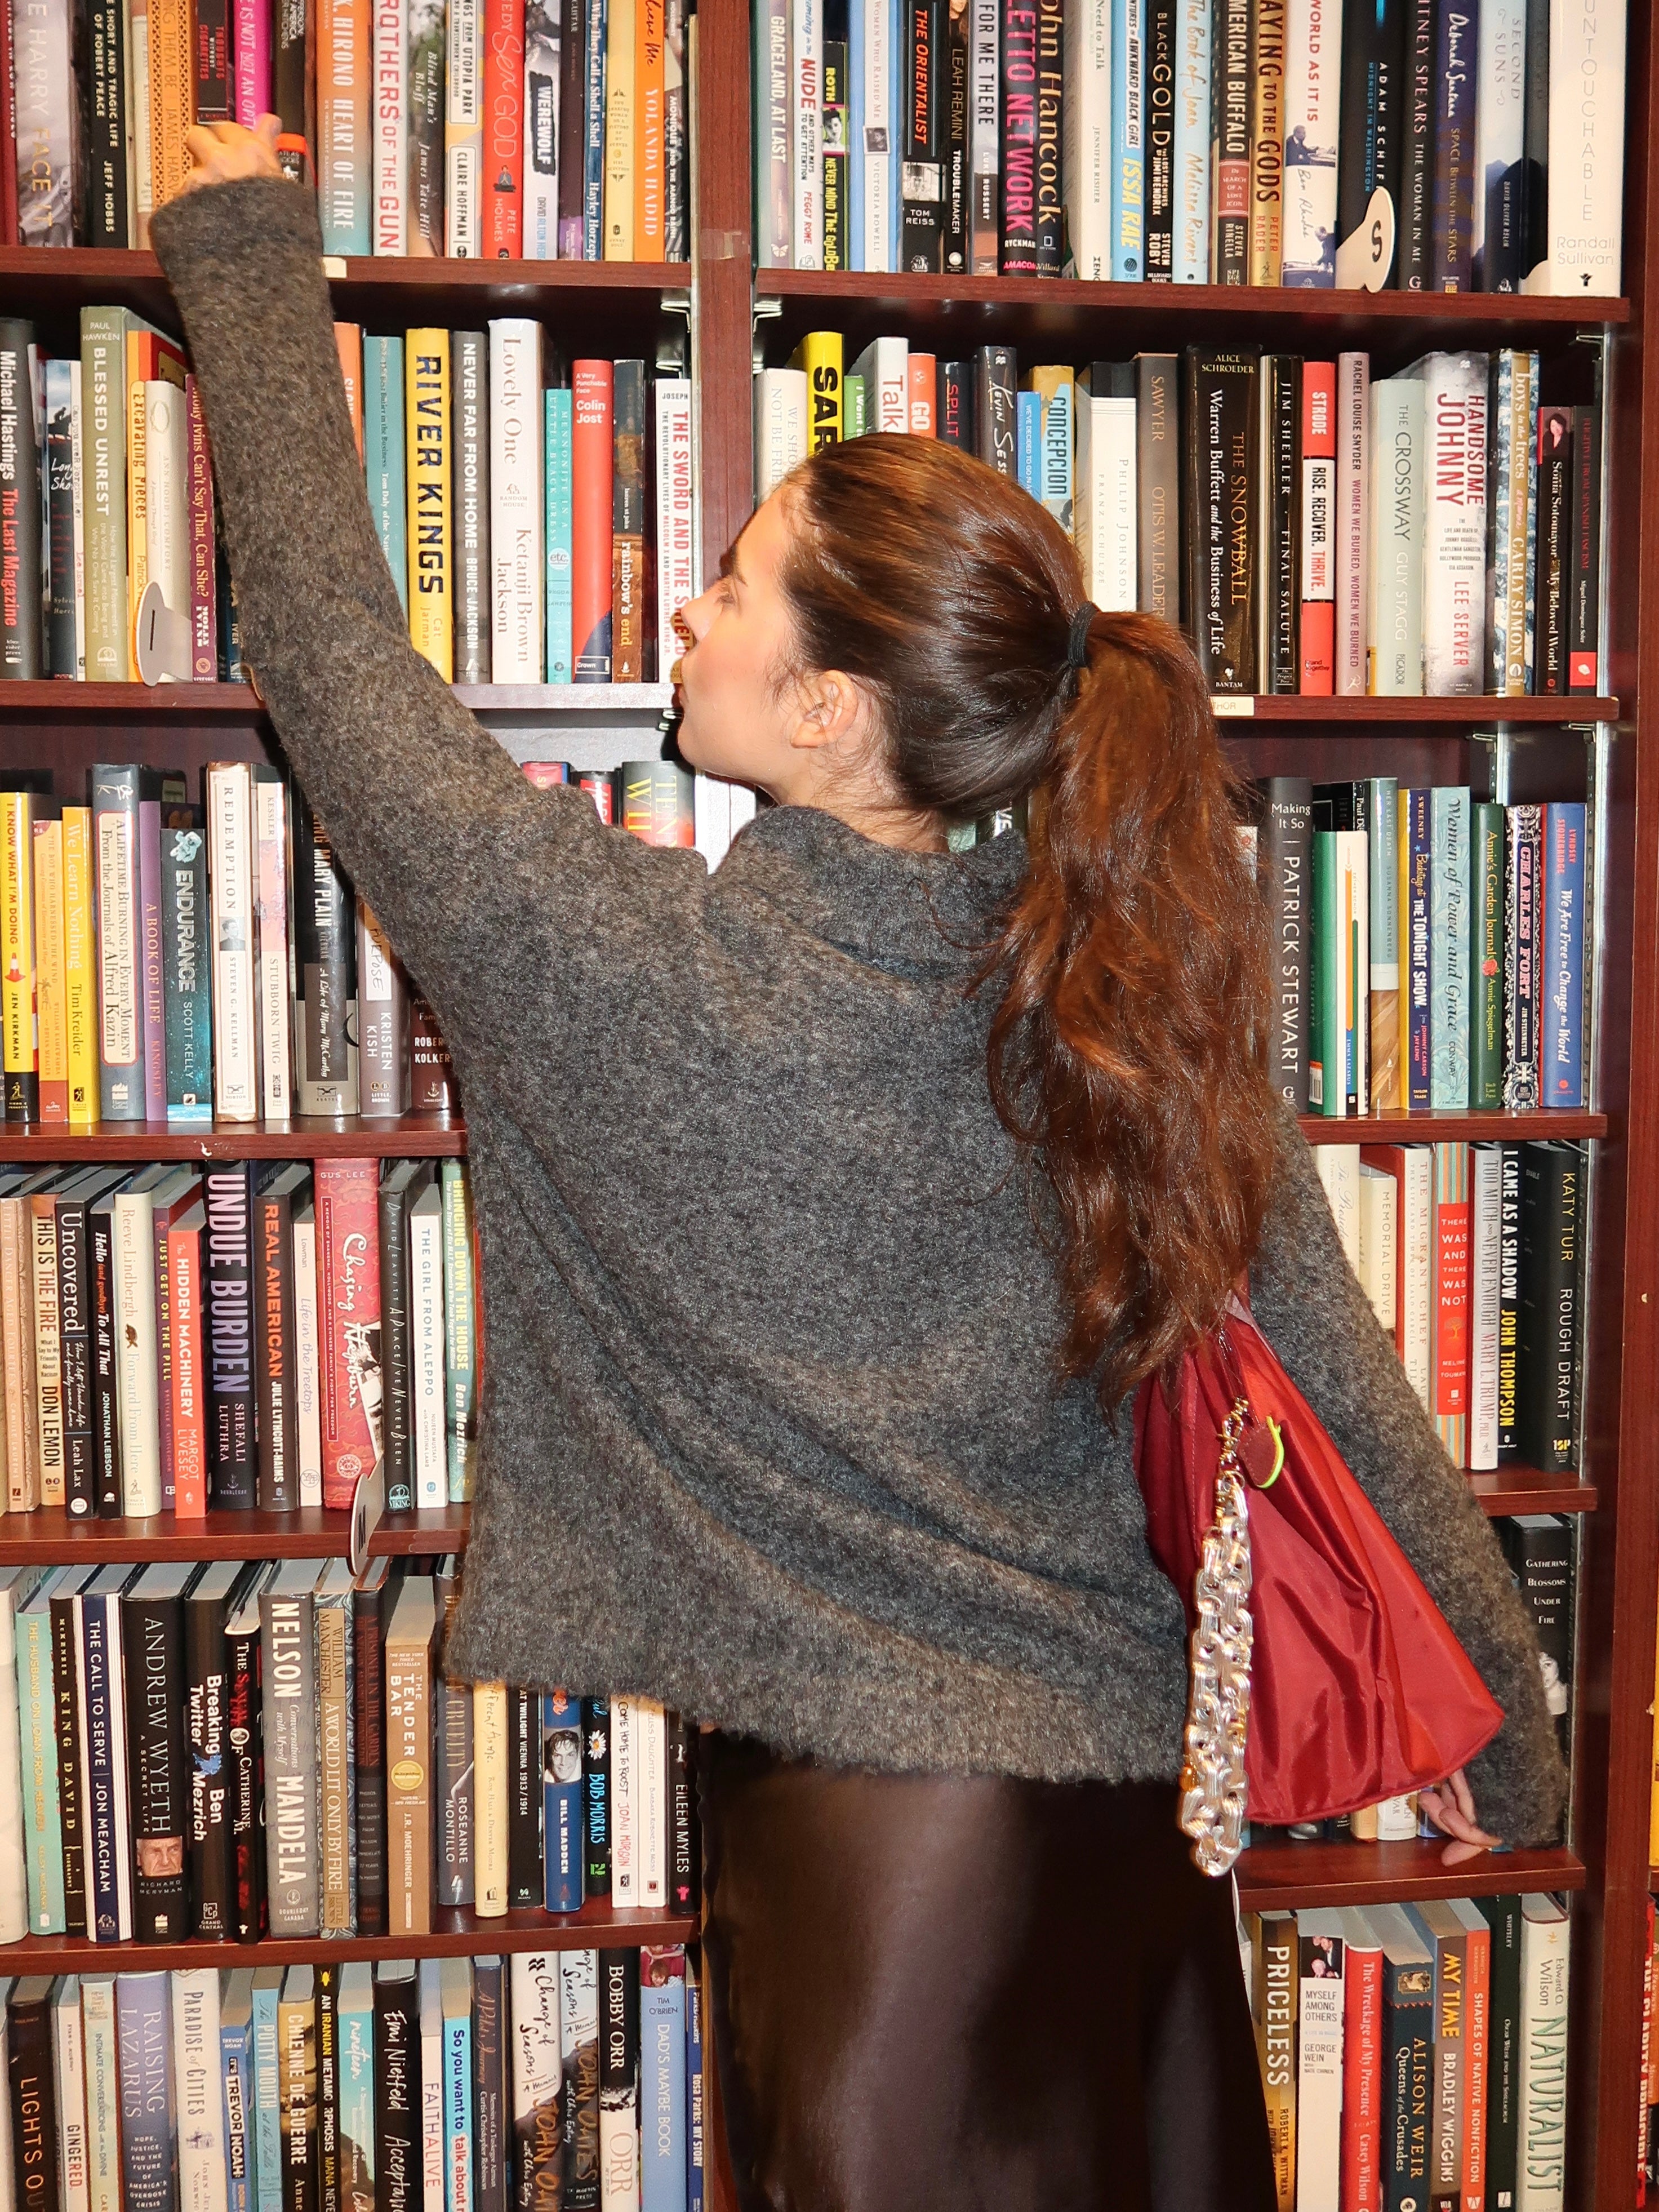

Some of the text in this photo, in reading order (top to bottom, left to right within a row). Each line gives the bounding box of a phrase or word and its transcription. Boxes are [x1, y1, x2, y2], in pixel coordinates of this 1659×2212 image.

[914, 9, 927, 144] THE ORIENTALIST
[332, 16, 353, 229] HIRONO HEART OF FIRE
[535, 85, 550, 165] WEREWOLF
[104, 161, 113, 233] JEFF HOBBS
[456, 152, 467, 237] CLAIRE HOFFMAN
[644, 88, 659, 236] YOLANDA HADID
[1412, 65, 1427, 262] SPEARS THE WOMAN IN ME
[905, 217, 935, 225] REISS
[1120, 157, 1141, 249] ISSA RAE
[1255, 215, 1264, 252] RADER
[1557, 237, 1614, 249] Randall
[1558, 252, 1613, 265] Sullivan
[501, 337, 522, 464] Lovely One
[1202, 363, 1254, 373] SCHROEDER
[94, 347, 108, 516] BLESSED UNREST
[577, 401, 606, 411] Colin
[577, 414, 602, 424] Jost
[1209, 388, 1222, 445] Warren
[1312, 391, 1326, 434] STRODE
[416, 355, 443, 593] RIVER KINGS
[1210, 451, 1225, 501] Buffett
[1436, 393, 1465, 506] JOHNNY
[1467, 396, 1484, 505] HANDSOME
[1, 352, 19, 627] Michael Hastings The Last Magazine
[464, 343, 478, 649] NEVER FAR FROM HOME BRUCE JACKSON
[1211, 505, 1221, 523] and
[1232, 432, 1247, 605] THE SNOWBALL
[1311, 467, 1326, 592] RISE. RECOVER. THRIVE.
[498, 558, 508, 633] Jackson
[517, 528, 532, 662] Ketanji Brown
[1210, 546, 1224, 612] Business
[1454, 581, 1469, 605] LEE
[1210, 612, 1224, 625] of
[1211, 627, 1225, 655] Life
[1453, 610, 1468, 666] SERVER
[7, 811, 16, 847] KNOW
[1271, 804, 1310, 815] Making
[1278, 819, 1304, 828] It So
[176, 870, 194, 1078] ENDURANCE SCOTT KELLY
[1282, 855, 1300, 1073] PATRICK STEWART
[367, 1025, 376, 1057] KISH
[381, 1011, 392, 1069] KRISTEN
[1503, 1160, 1518, 1197] CAME
[1503, 1201, 1518, 1220] AS
[1503, 1225, 1518, 1234] A
[61, 1212, 84, 1332] Uncovered
[208, 1175, 249, 1394] UNDUE BURDEN
[265, 1206, 283, 1377] REAL AMERICAN
[1502, 1236, 1516, 1299] SHADOW
[1558, 1172, 1575, 1420] KATY TUR ROUGH DRAFT
[177, 1258, 193, 1418] HIDDEN MACHINERY
[1502, 1309, 1516, 1347] JOHN
[1500, 1352, 1515, 1427] THOMPSON
[72, 1440, 83, 1487] Leah Lax
[179, 1428, 187, 1479] LIVESEY
[187, 1429, 198, 1481] MARGOT
[219, 1405, 228, 1462] LUTHRA
[235, 1403, 246, 1462] SHEFALI
[272, 1603, 301, 1698] NELSON
[145, 1618, 171, 1833] ANDREW WYETH
[190, 1684, 202, 1746] Twitter
[207, 1676, 222, 1754] Breaking
[192, 1771, 206, 1842] Mezrich
[209, 1788, 224, 1824] Ben
[276, 1775, 306, 1884] MANDELA
[676, 1784, 689, 1873] EILEEN MYLES
[608, 1965, 624, 2070] BOBBY ORR
[1267, 1946, 1289, 2085] PRICELESS
[1305, 2001, 1335, 2010] AMONG
[1305, 2012, 1337, 2022] OTHERS
[121, 2009, 141, 2118] LAZARUS
[143, 2010, 164, 2113] RAISING
[1305, 2044, 1336, 2053] GEORGE
[1305, 2053, 1324, 2062] WEIN
[1441, 1953, 1461, 2183] MY TIME BRADLEY WIGGINS
[1411, 2037, 1426, 2178] ALISON WEIR
[1527, 2015, 1566, 2192] NATURALIST
